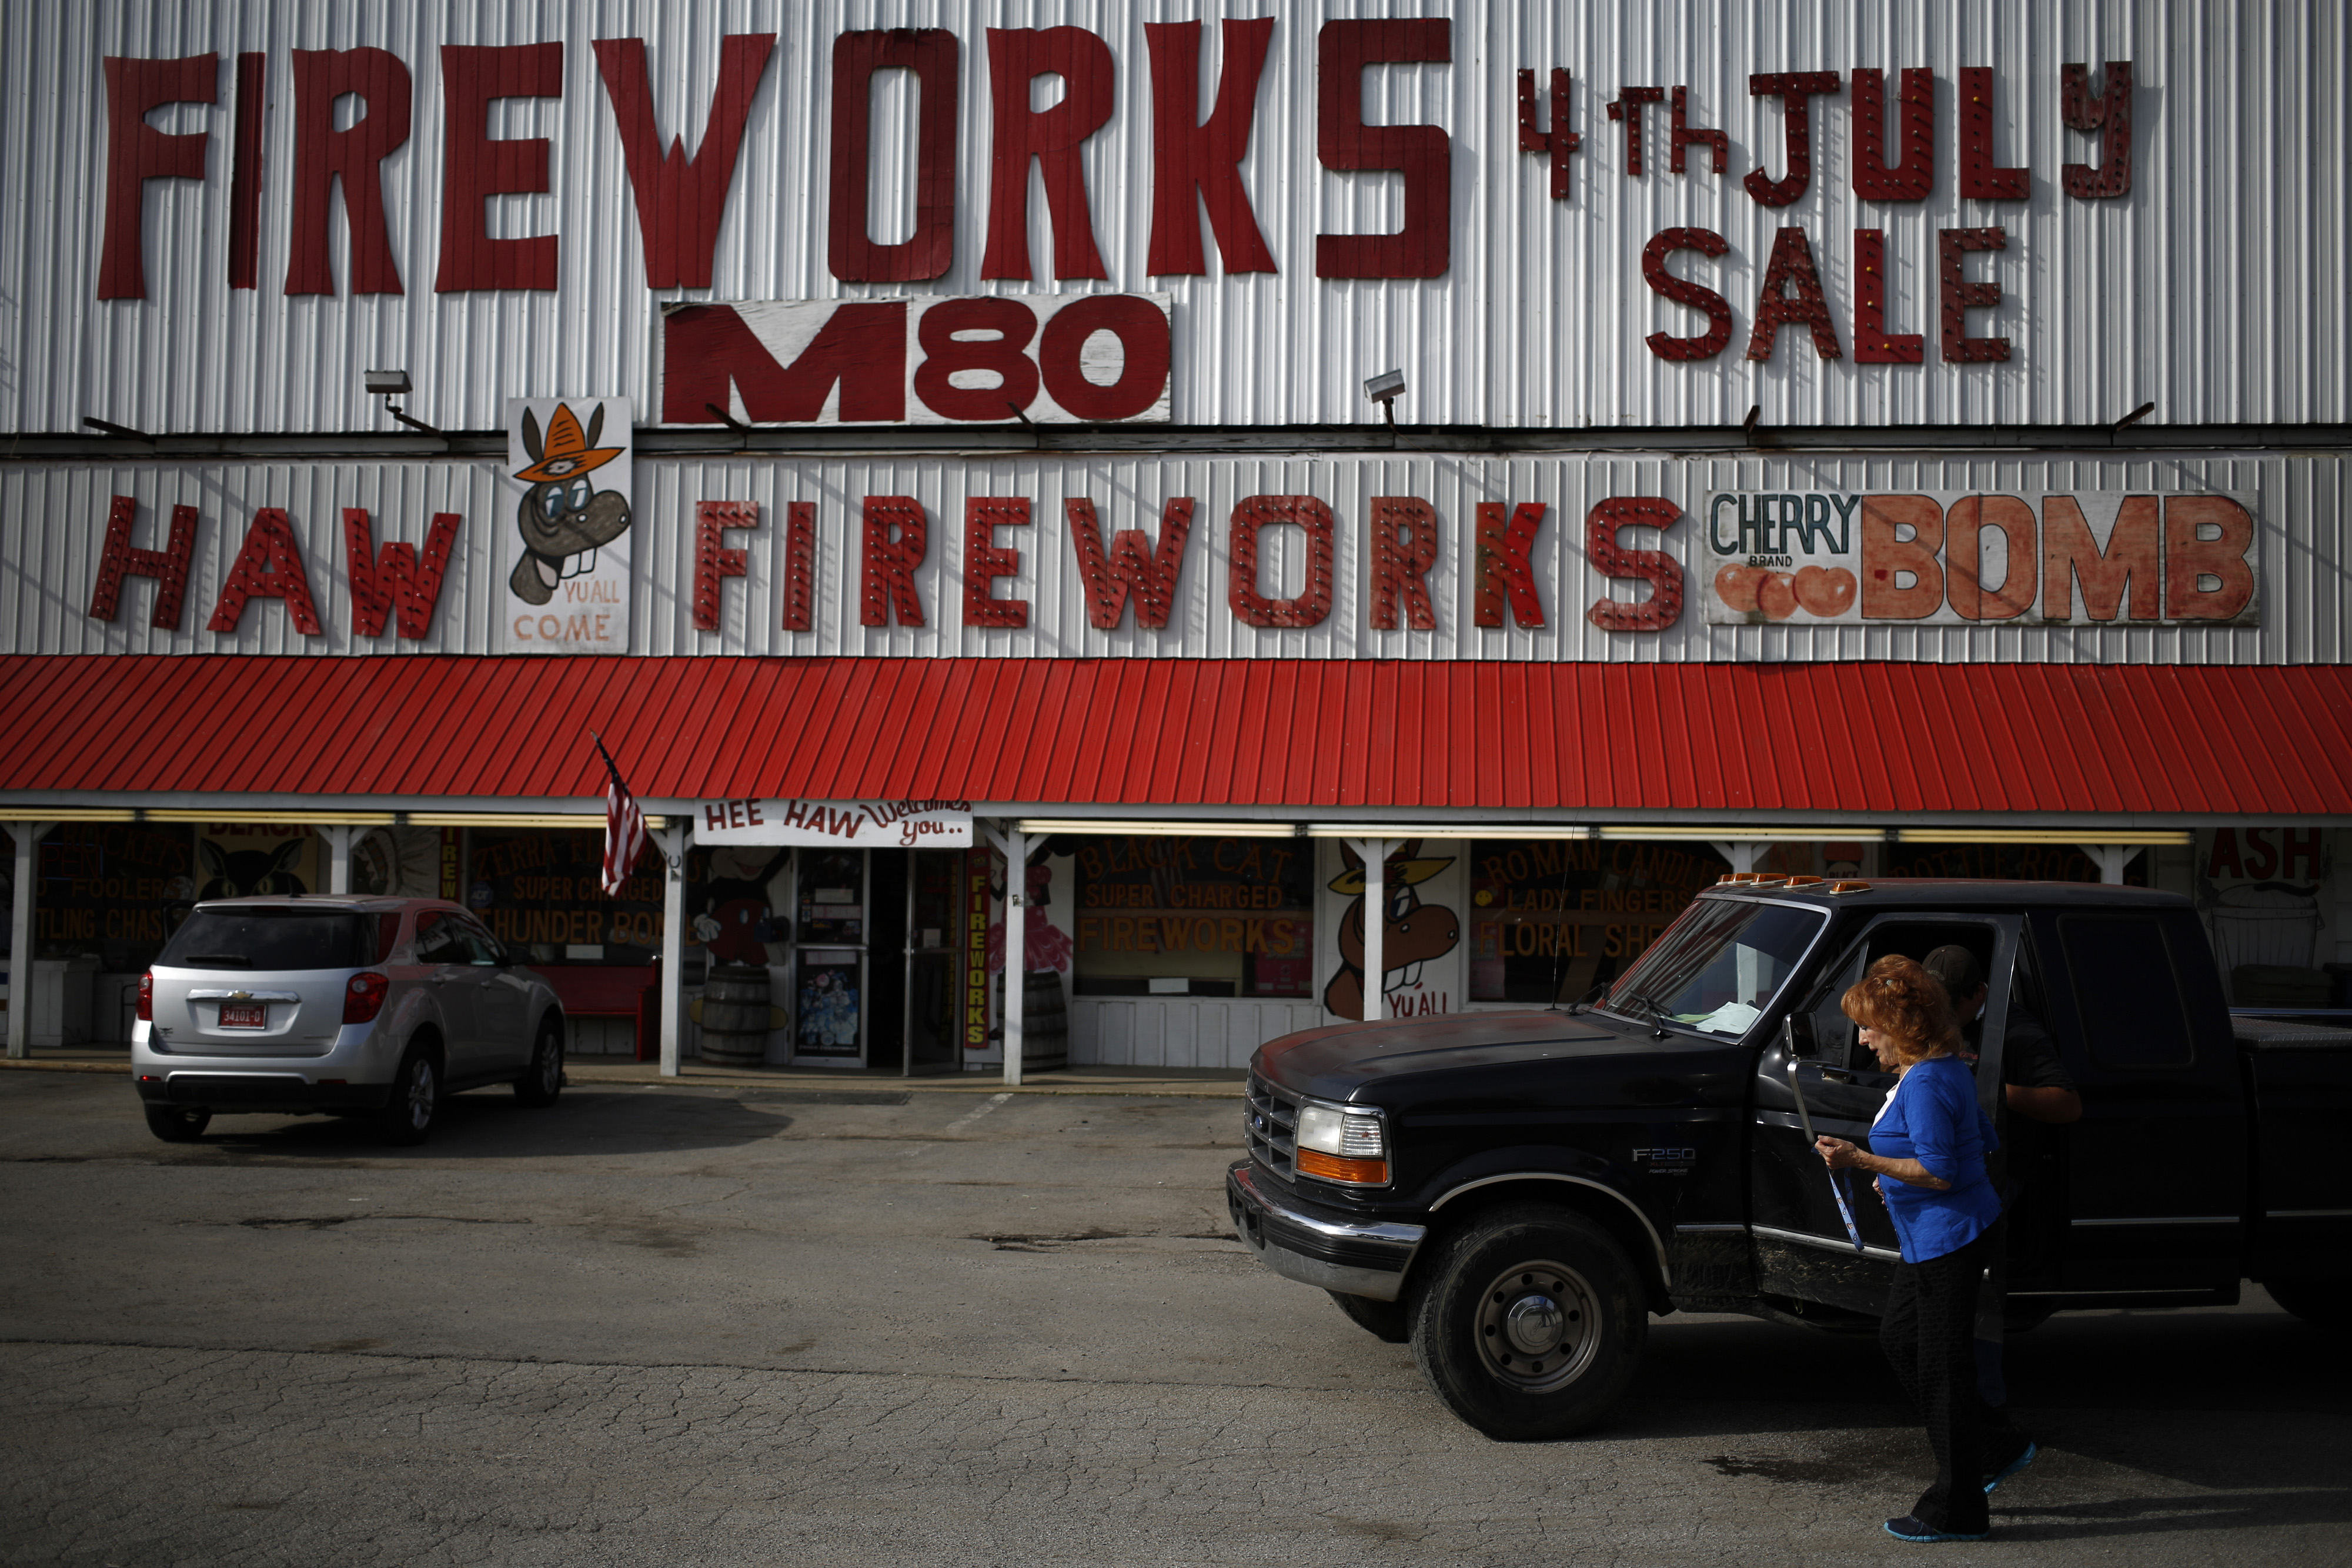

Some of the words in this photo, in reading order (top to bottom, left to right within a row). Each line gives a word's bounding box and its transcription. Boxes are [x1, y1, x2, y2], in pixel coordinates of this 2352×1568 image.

[98, 16, 1451, 300] FIREWORKS
[1642, 226, 2010, 364] SALE
[664, 294, 1170, 423] M80
[1710, 494, 1860, 554] CHERRY
[89, 495, 461, 641] HAW
[693, 494, 1684, 631] FIREWORKS
[1749, 556, 1792, 566] BRAND
[1862, 494, 2254, 621] BOMB
[513, 614, 611, 641] COME
[705, 799, 764, 830] HEE
[784, 799, 865, 838] HAW
[38, 845, 100, 878] PEN
[59, 822, 191, 874] ROCKETS
[1077, 835, 1198, 880] BLACK
[1214, 837, 1294, 884] CAT
[1480, 839, 1601, 889] ROMAN
[2207, 827, 2321, 880] ASH
[71, 878, 181, 900] FOOLERS
[513, 875, 573, 901] SUPER
[1085, 883, 1156, 908] SUPER
[1170, 884, 1283, 910] CHARGED
[1506, 888, 1570, 912] LADY
[1579, 888, 1692, 913] FINGERS
[473, 908, 603, 944] THUNDER
[1078, 916, 1296, 954] FIREWORKS
[1479, 921, 1588, 958] FLORAL
[967, 875, 987, 1044] FIREWORKS
